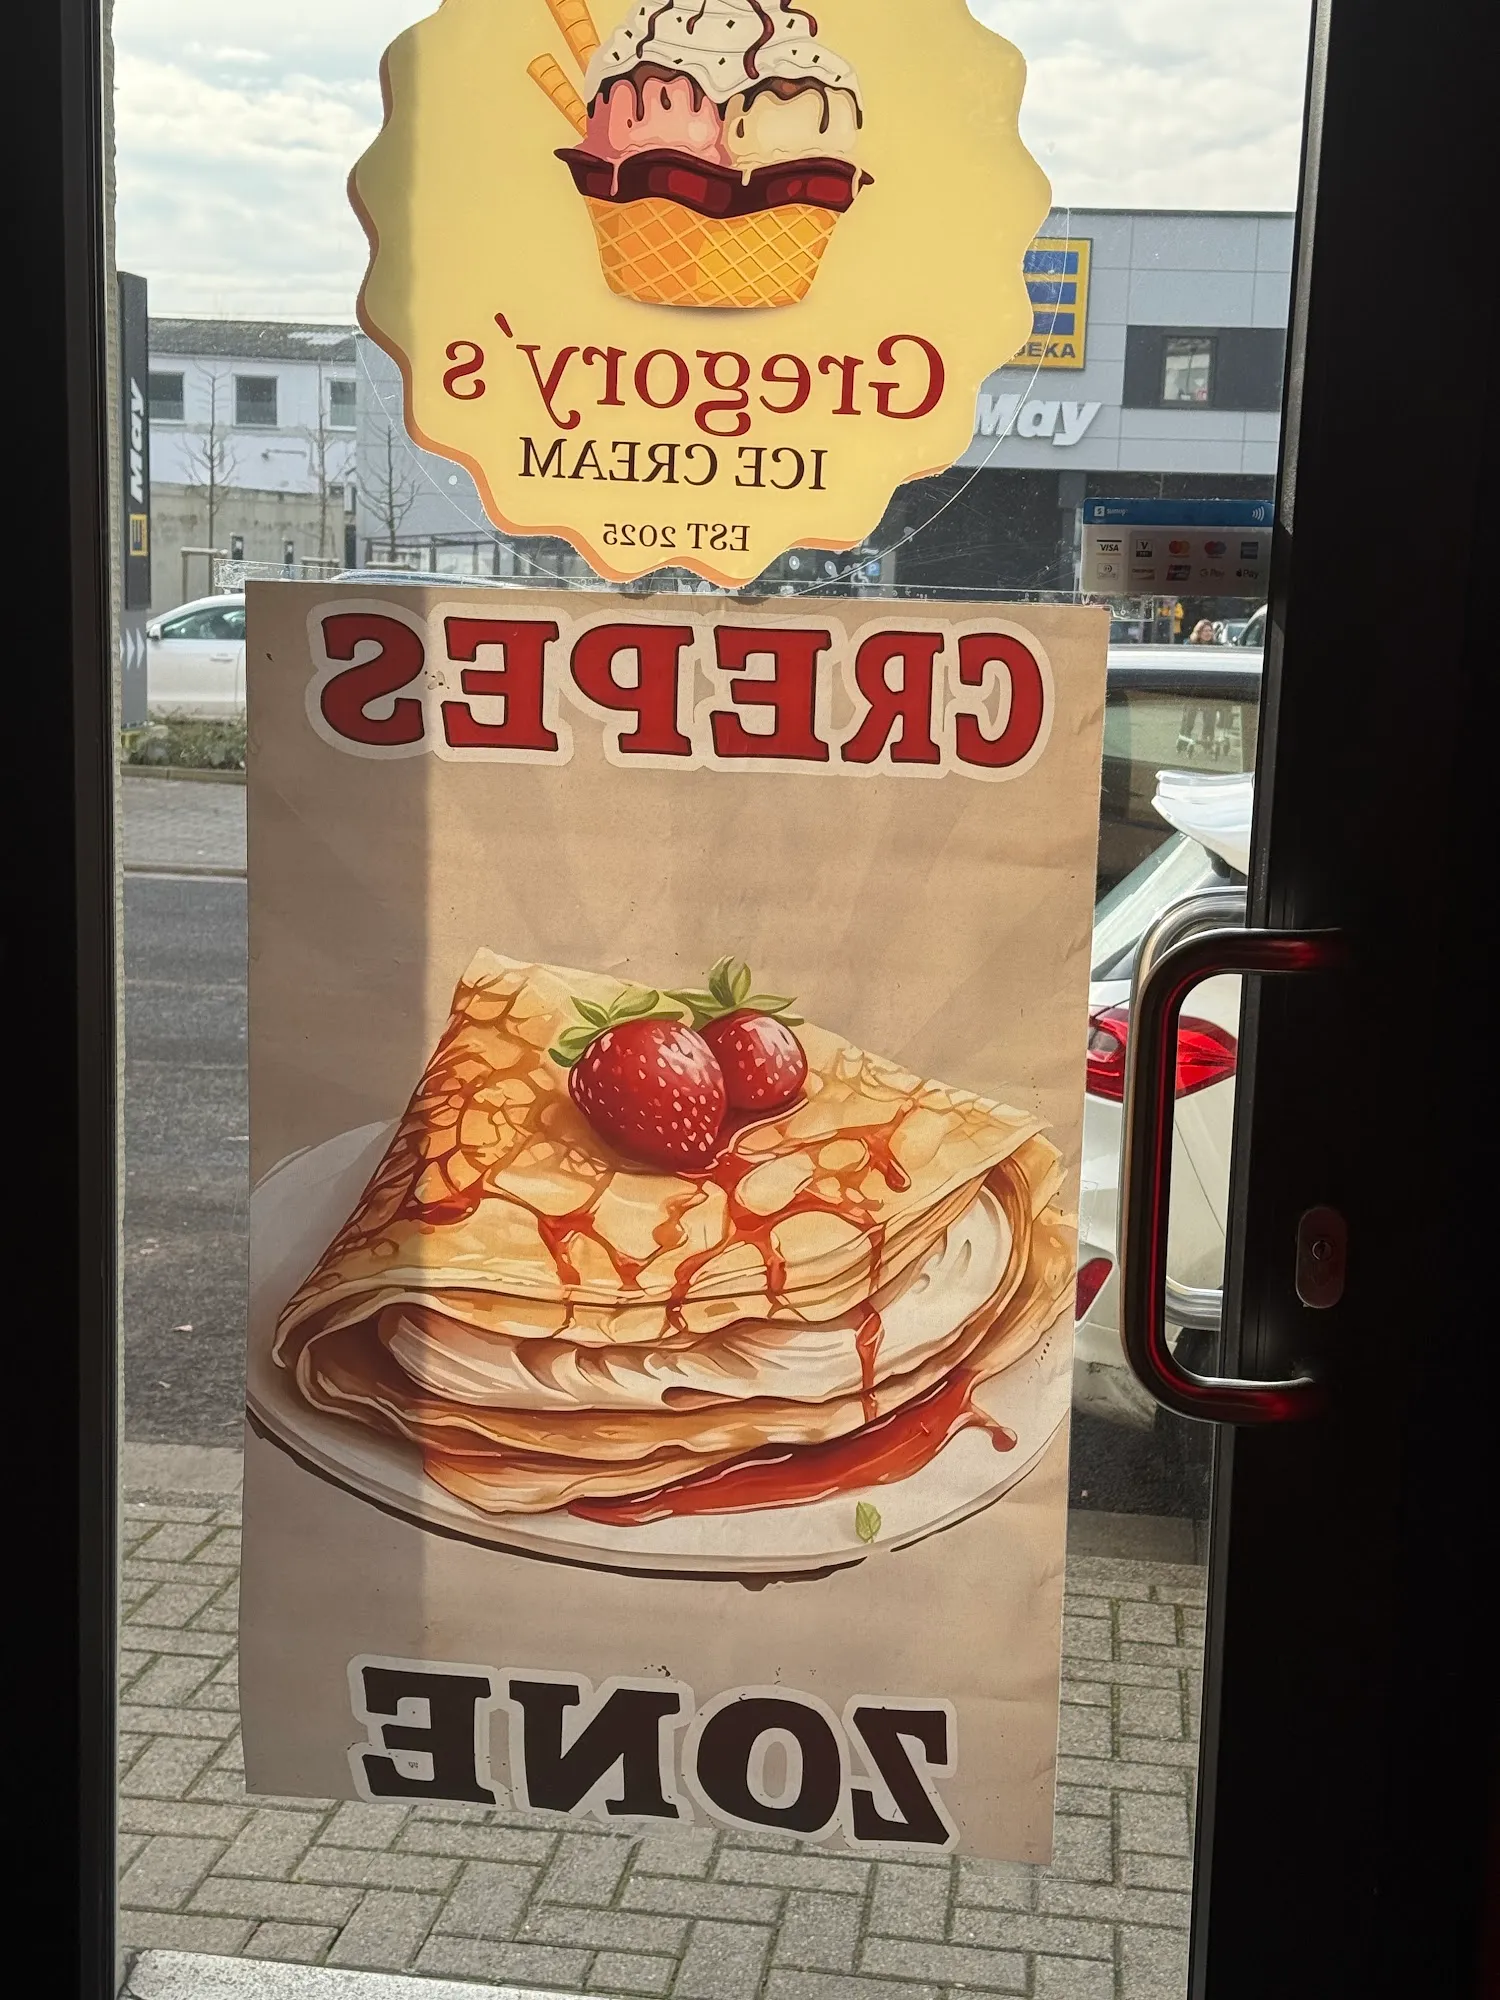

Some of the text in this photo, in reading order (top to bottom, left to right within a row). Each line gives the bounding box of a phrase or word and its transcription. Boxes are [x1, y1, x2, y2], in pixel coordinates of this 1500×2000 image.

[130, 376, 145, 504] May
[974, 393, 1102, 446] May
[1100, 544, 1119, 552] VISA
